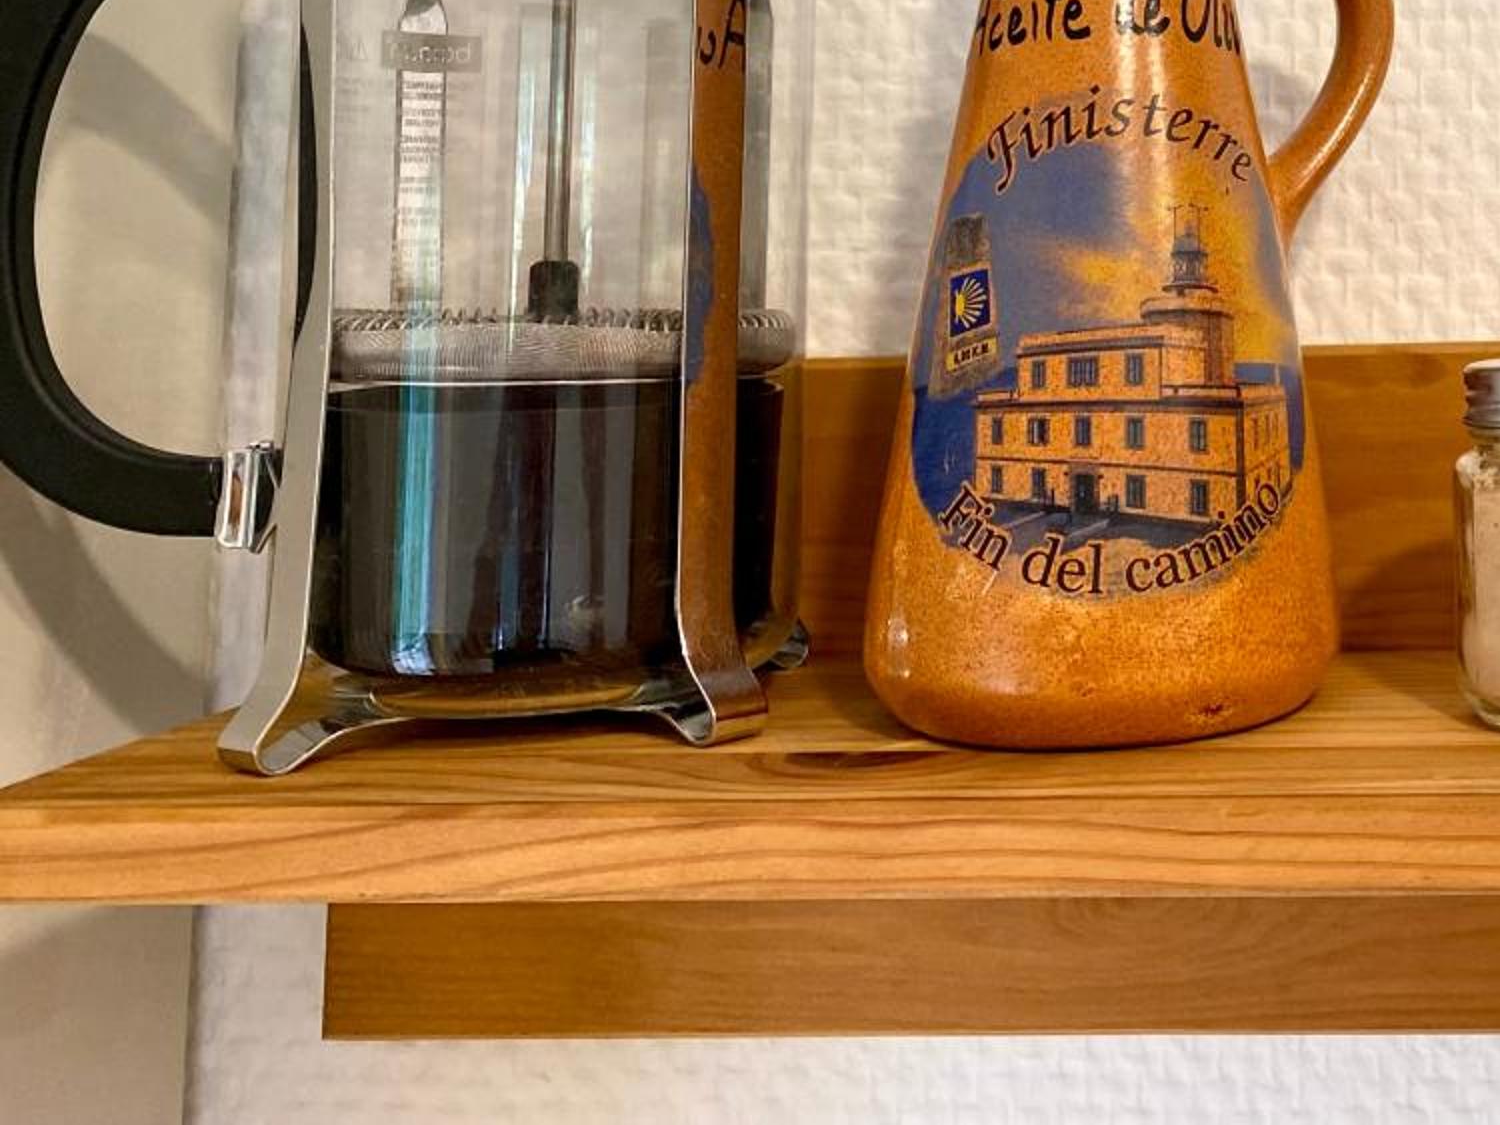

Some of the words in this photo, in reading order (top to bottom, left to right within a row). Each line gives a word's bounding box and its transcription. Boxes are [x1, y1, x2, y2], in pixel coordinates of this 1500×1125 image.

[986, 85, 1253, 192] Finisterre
[939, 482, 1010, 571] Fin
[1021, 532, 1104, 594] del
